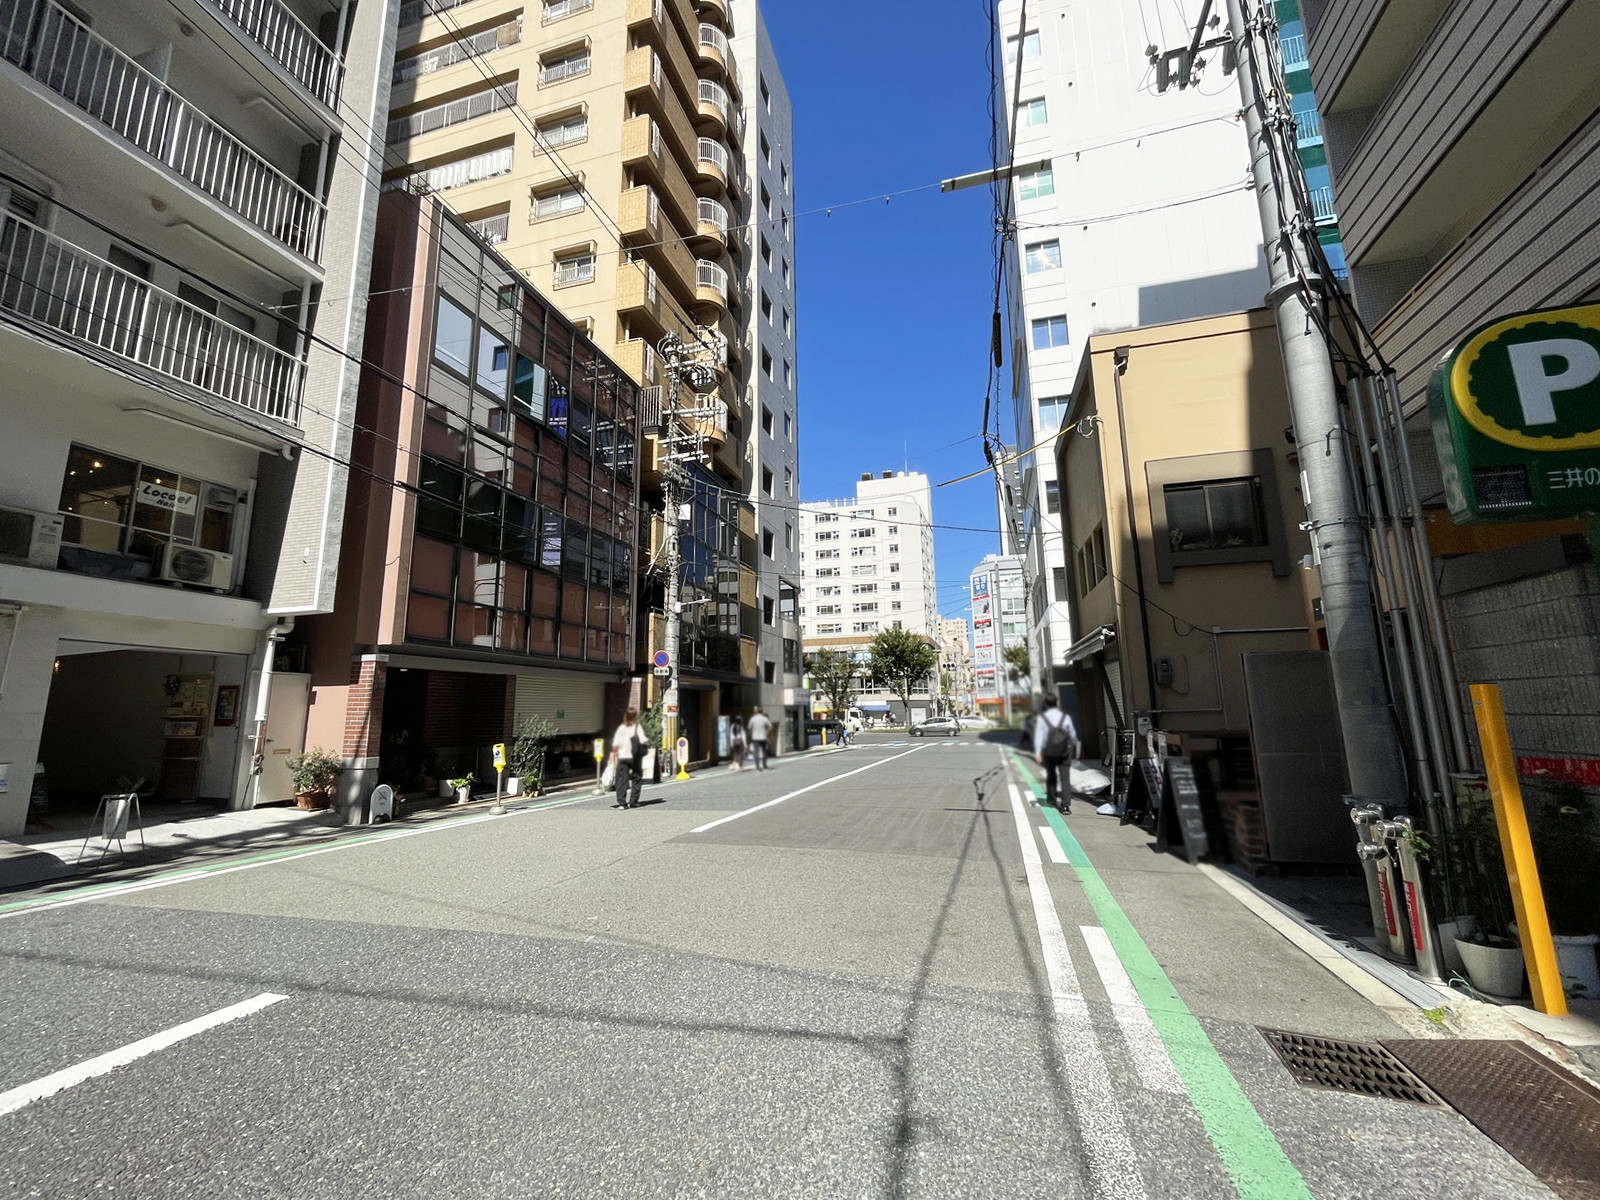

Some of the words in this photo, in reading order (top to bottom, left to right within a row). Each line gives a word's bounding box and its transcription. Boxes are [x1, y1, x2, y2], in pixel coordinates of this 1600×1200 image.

[1507, 338, 1600, 426] P
[1548, 467, 1600, 489] 三井の
[143, 485, 192, 505] Locoel
